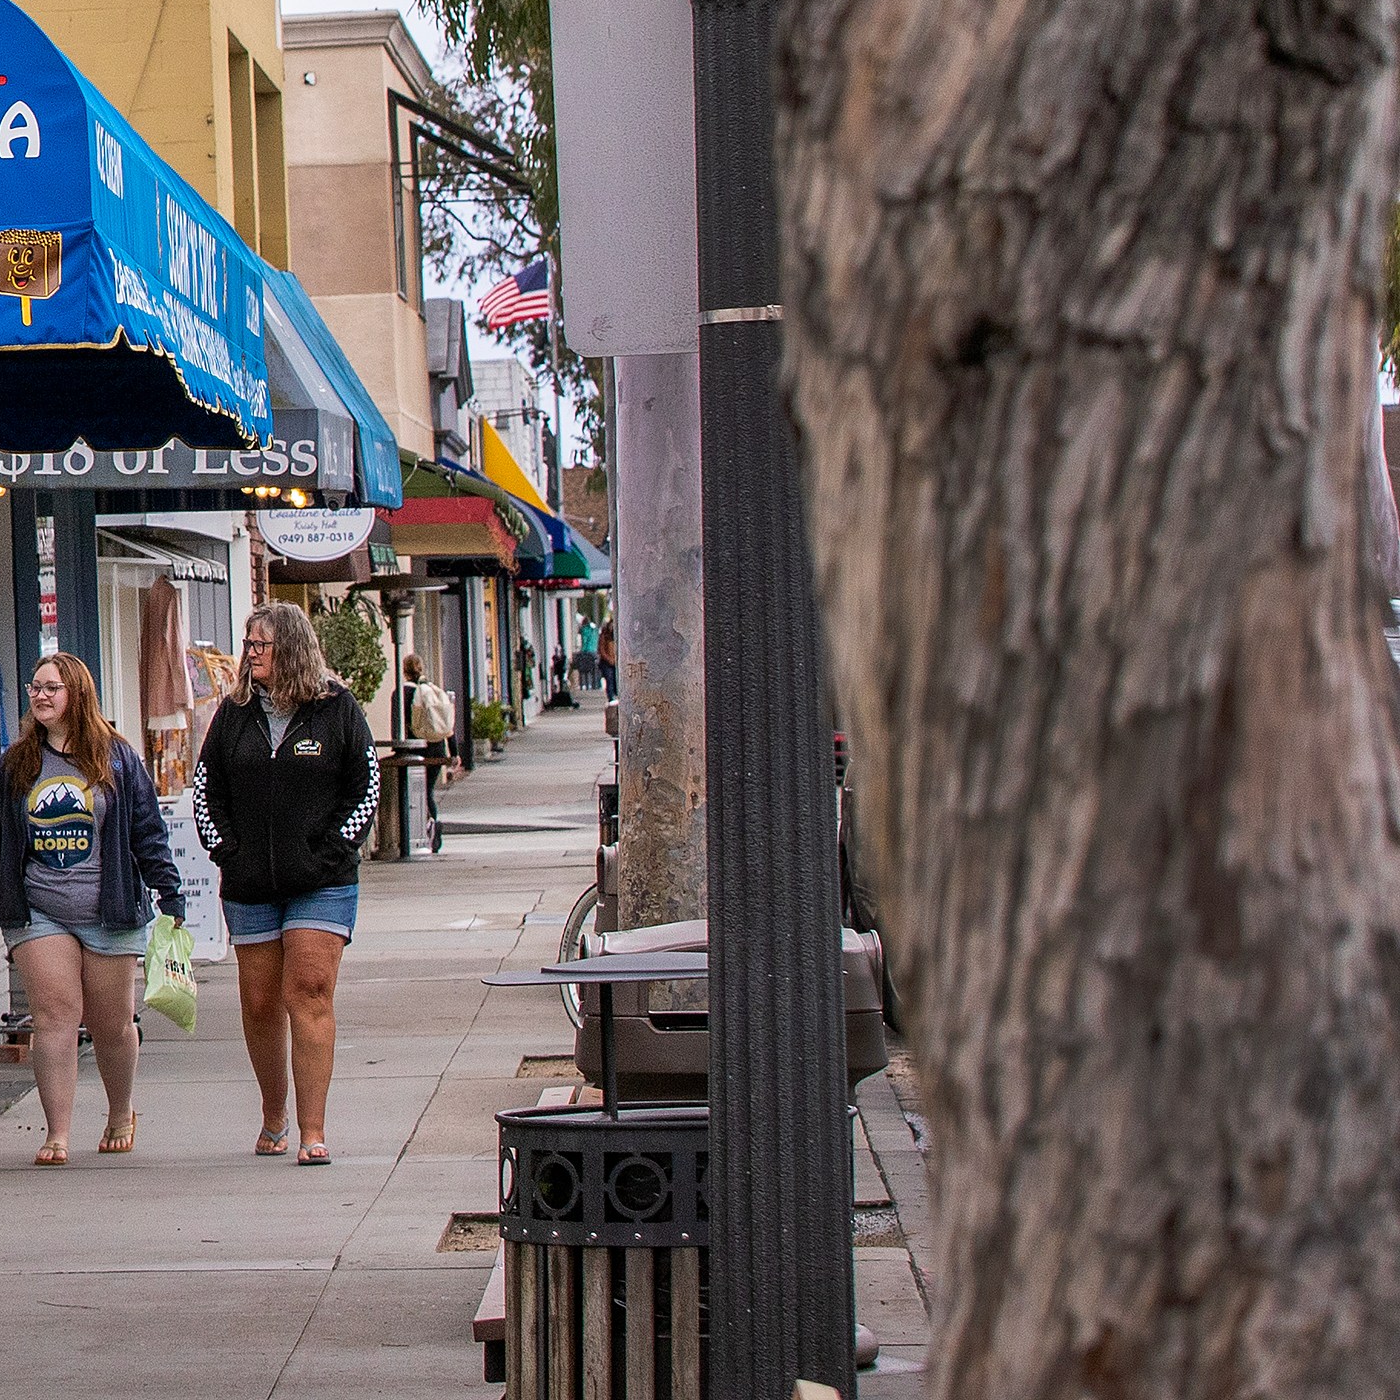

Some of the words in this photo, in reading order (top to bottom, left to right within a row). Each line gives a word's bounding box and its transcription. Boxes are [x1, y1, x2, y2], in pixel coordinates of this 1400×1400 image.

[193, 438, 317, 476] Less
[278, 534, 304, 543] (949)
[307, 532, 354, 542] 887-0318
[34, 837, 89, 851] RODEO
